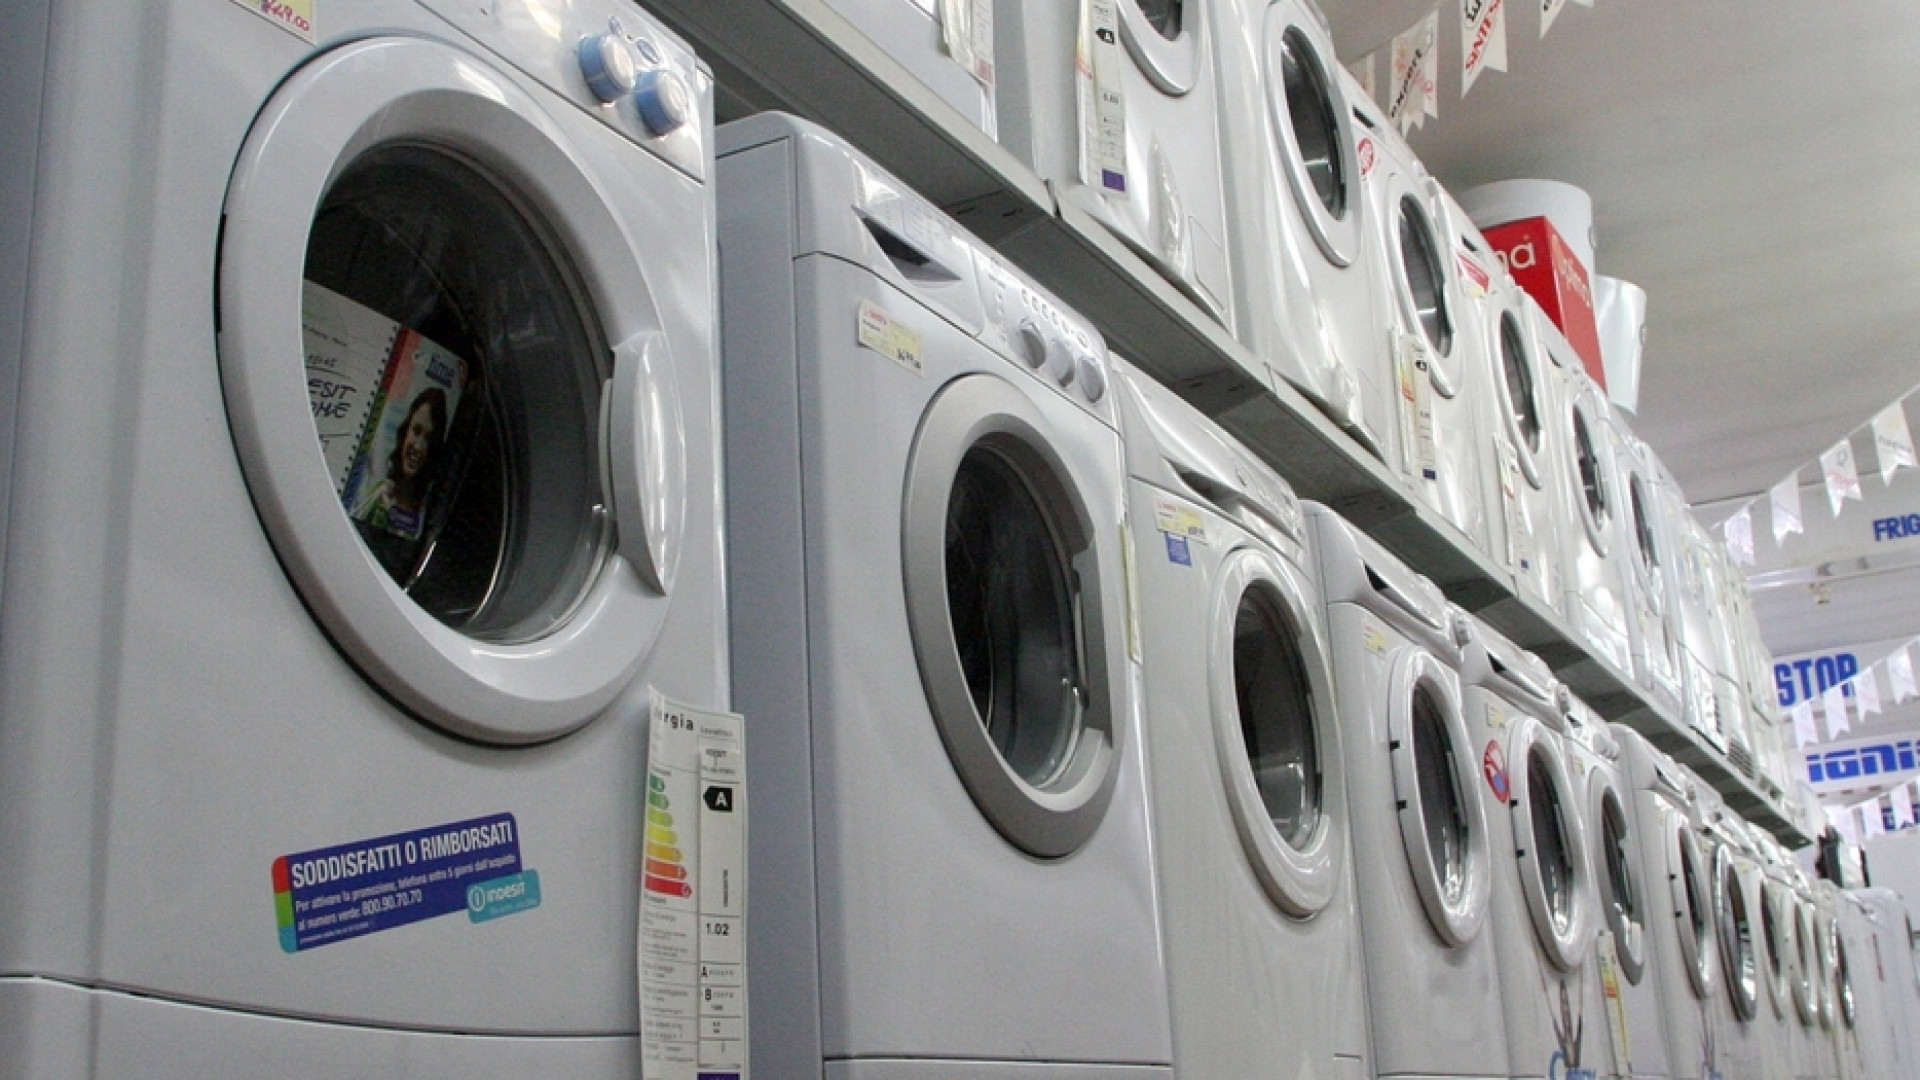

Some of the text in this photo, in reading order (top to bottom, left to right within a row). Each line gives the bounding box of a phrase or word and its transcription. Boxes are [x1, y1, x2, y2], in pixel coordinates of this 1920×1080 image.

[715, 791, 729, 808] A
[291, 821, 513, 889] SODDISFATTI O RIMBORSATI
[705, 922, 730, 937] 1.02
